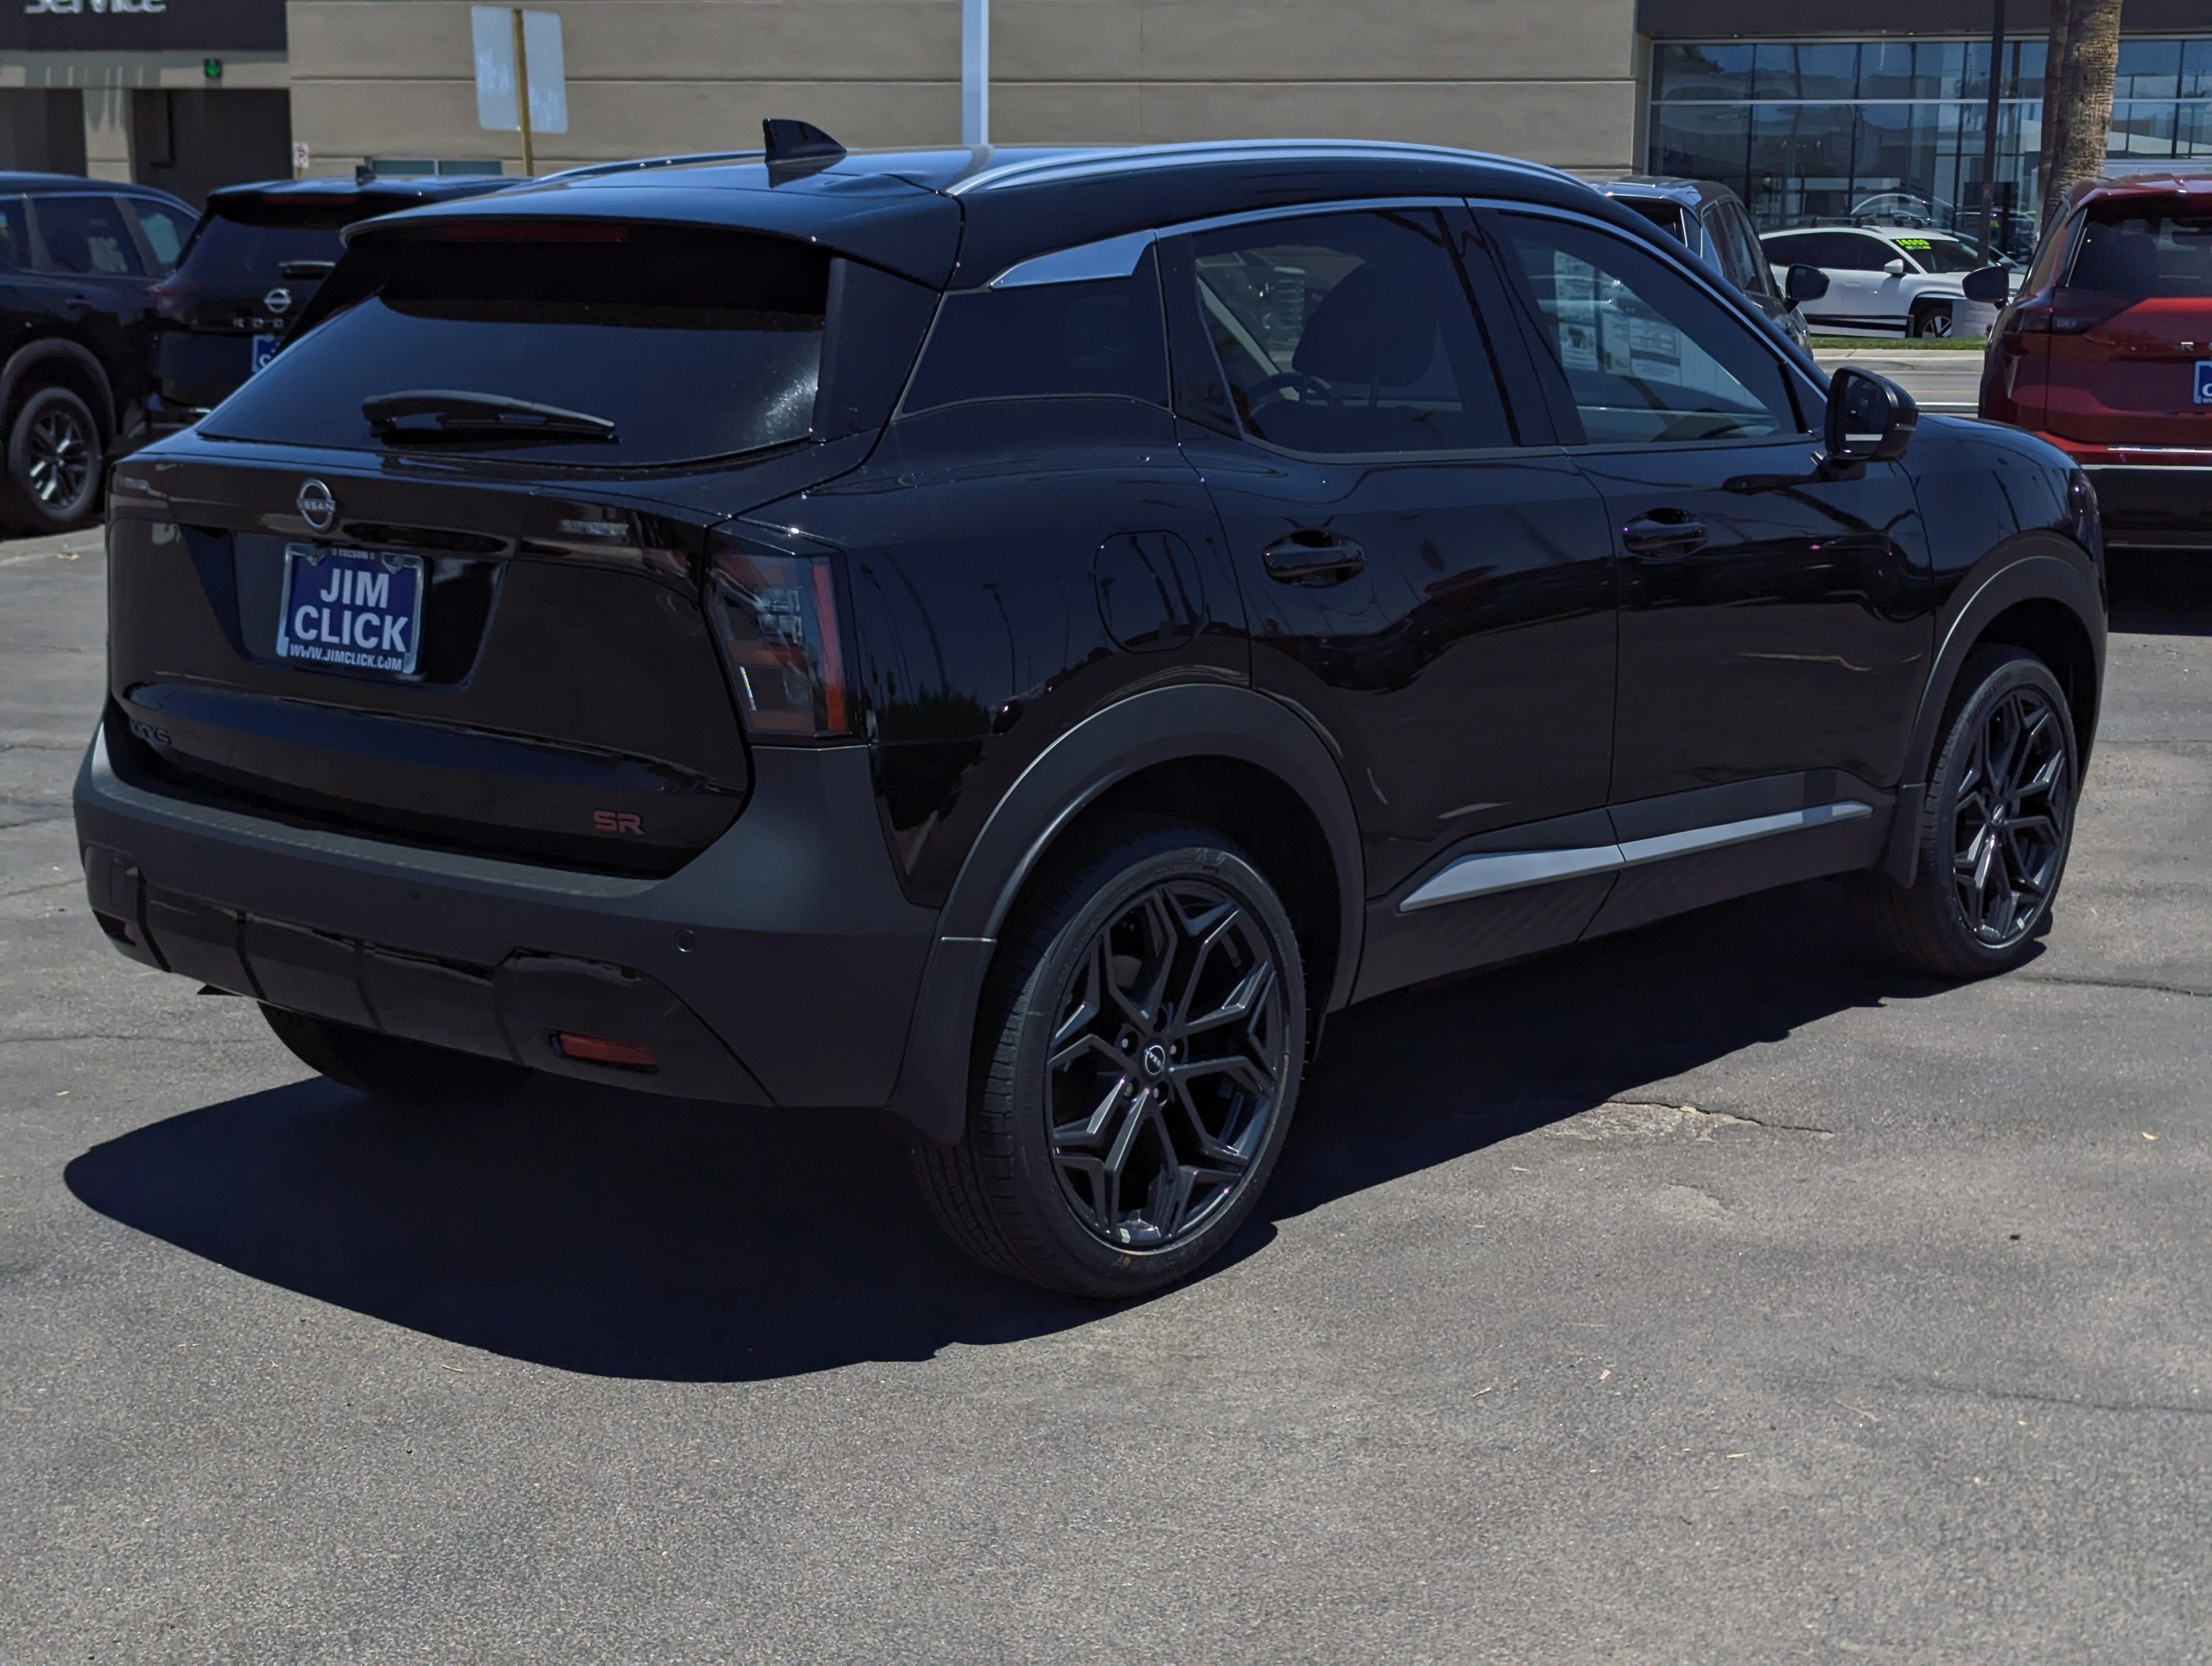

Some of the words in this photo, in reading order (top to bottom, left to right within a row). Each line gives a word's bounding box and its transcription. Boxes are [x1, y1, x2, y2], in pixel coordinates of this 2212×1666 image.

[320, 568, 390, 608] JIM
[294, 605, 409, 653] CLICK
[290, 643, 402, 671] WWW.JIMCLICK.COM
[593, 810, 644, 835] SR
